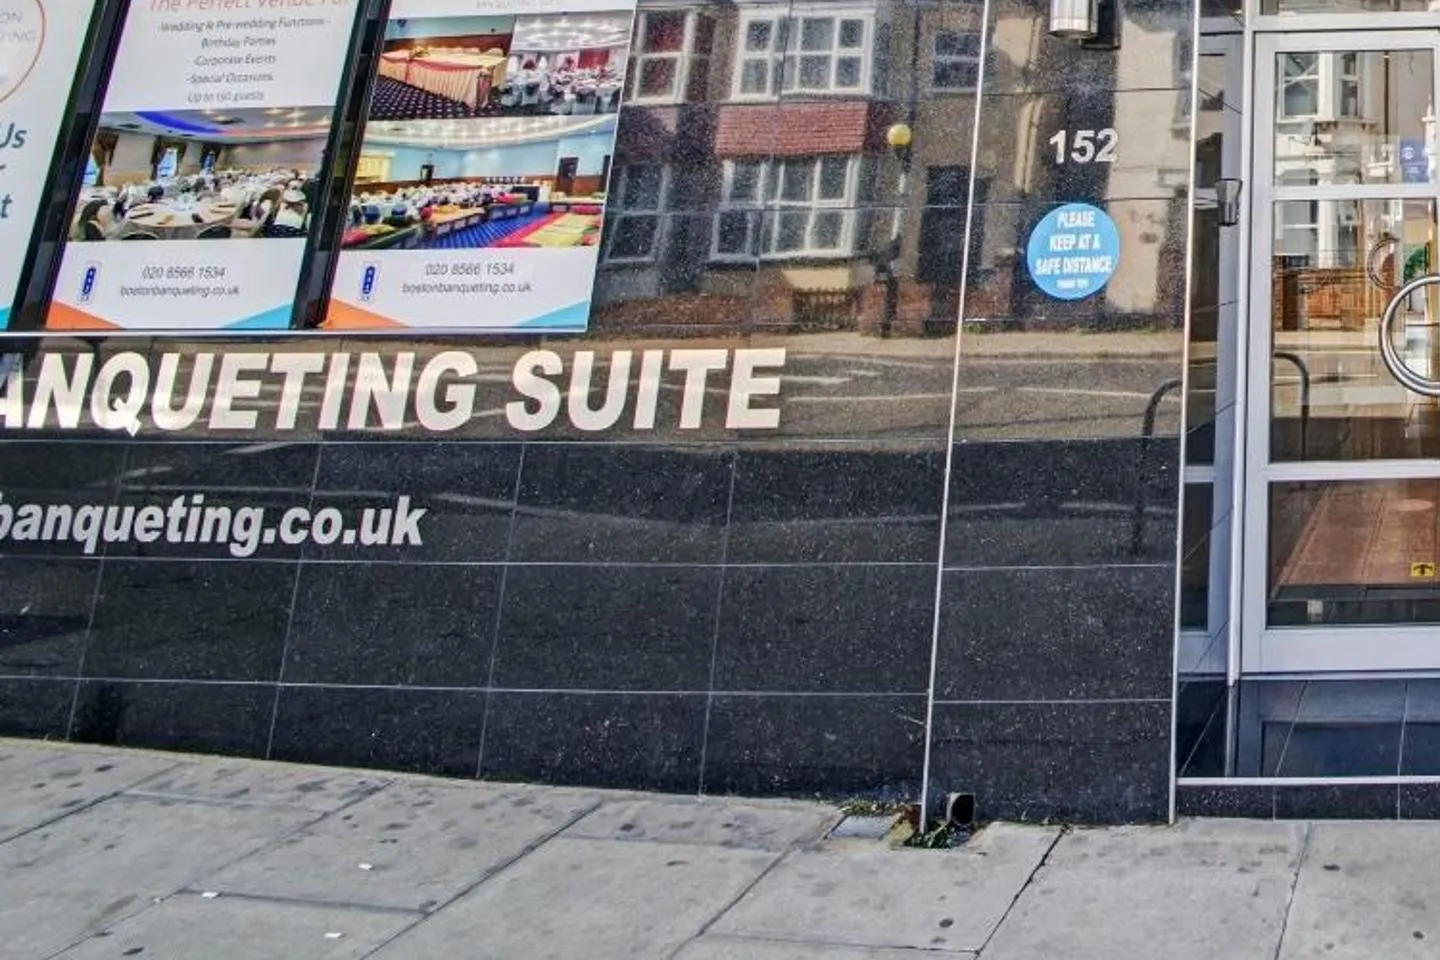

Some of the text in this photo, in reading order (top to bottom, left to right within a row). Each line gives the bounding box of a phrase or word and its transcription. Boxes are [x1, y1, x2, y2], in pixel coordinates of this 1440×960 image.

[1049, 128, 1119, 165] 152
[1057, 211, 1096, 228] PLEASE
[1050, 234, 1076, 252] KEEP
[142, 267, 164, 279] 020
[425, 263, 448, 275] 020
[1035, 257, 1061, 275] SAFE
[505, 348, 786, 431] SUITE
